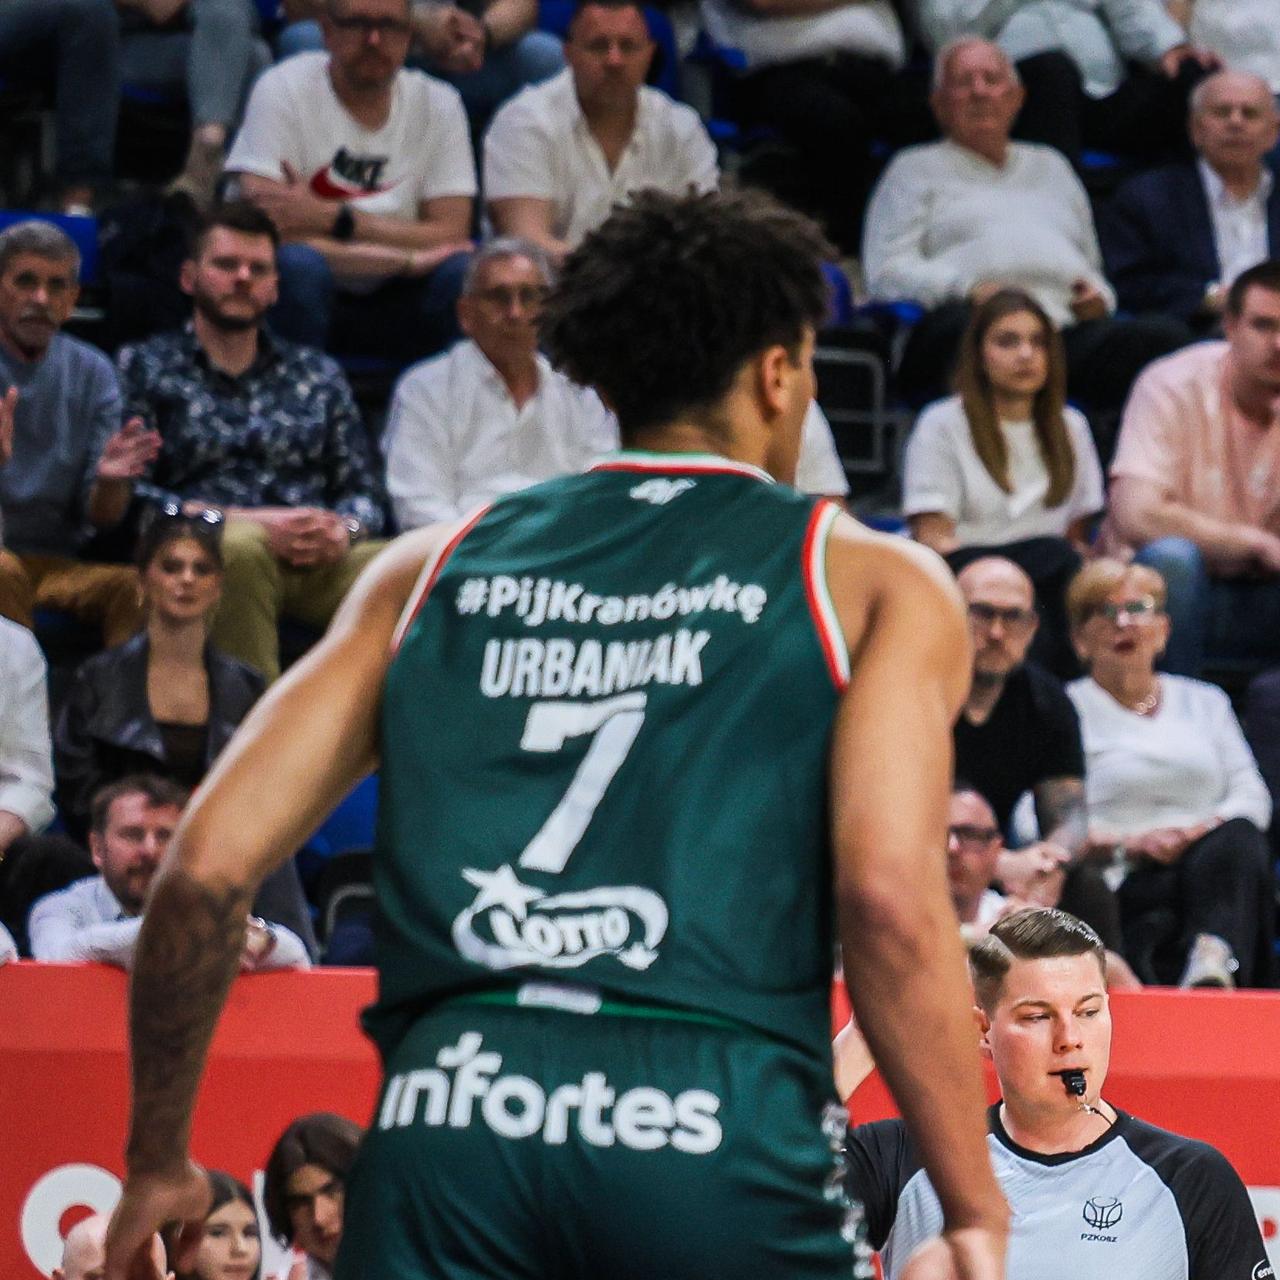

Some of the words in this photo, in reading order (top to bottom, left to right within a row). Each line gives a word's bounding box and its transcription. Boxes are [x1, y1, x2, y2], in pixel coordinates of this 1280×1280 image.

[455, 574, 768, 627] #PijKranówkę
[479, 628, 713, 699] URBANIAK
[518, 690, 648, 874] 7
